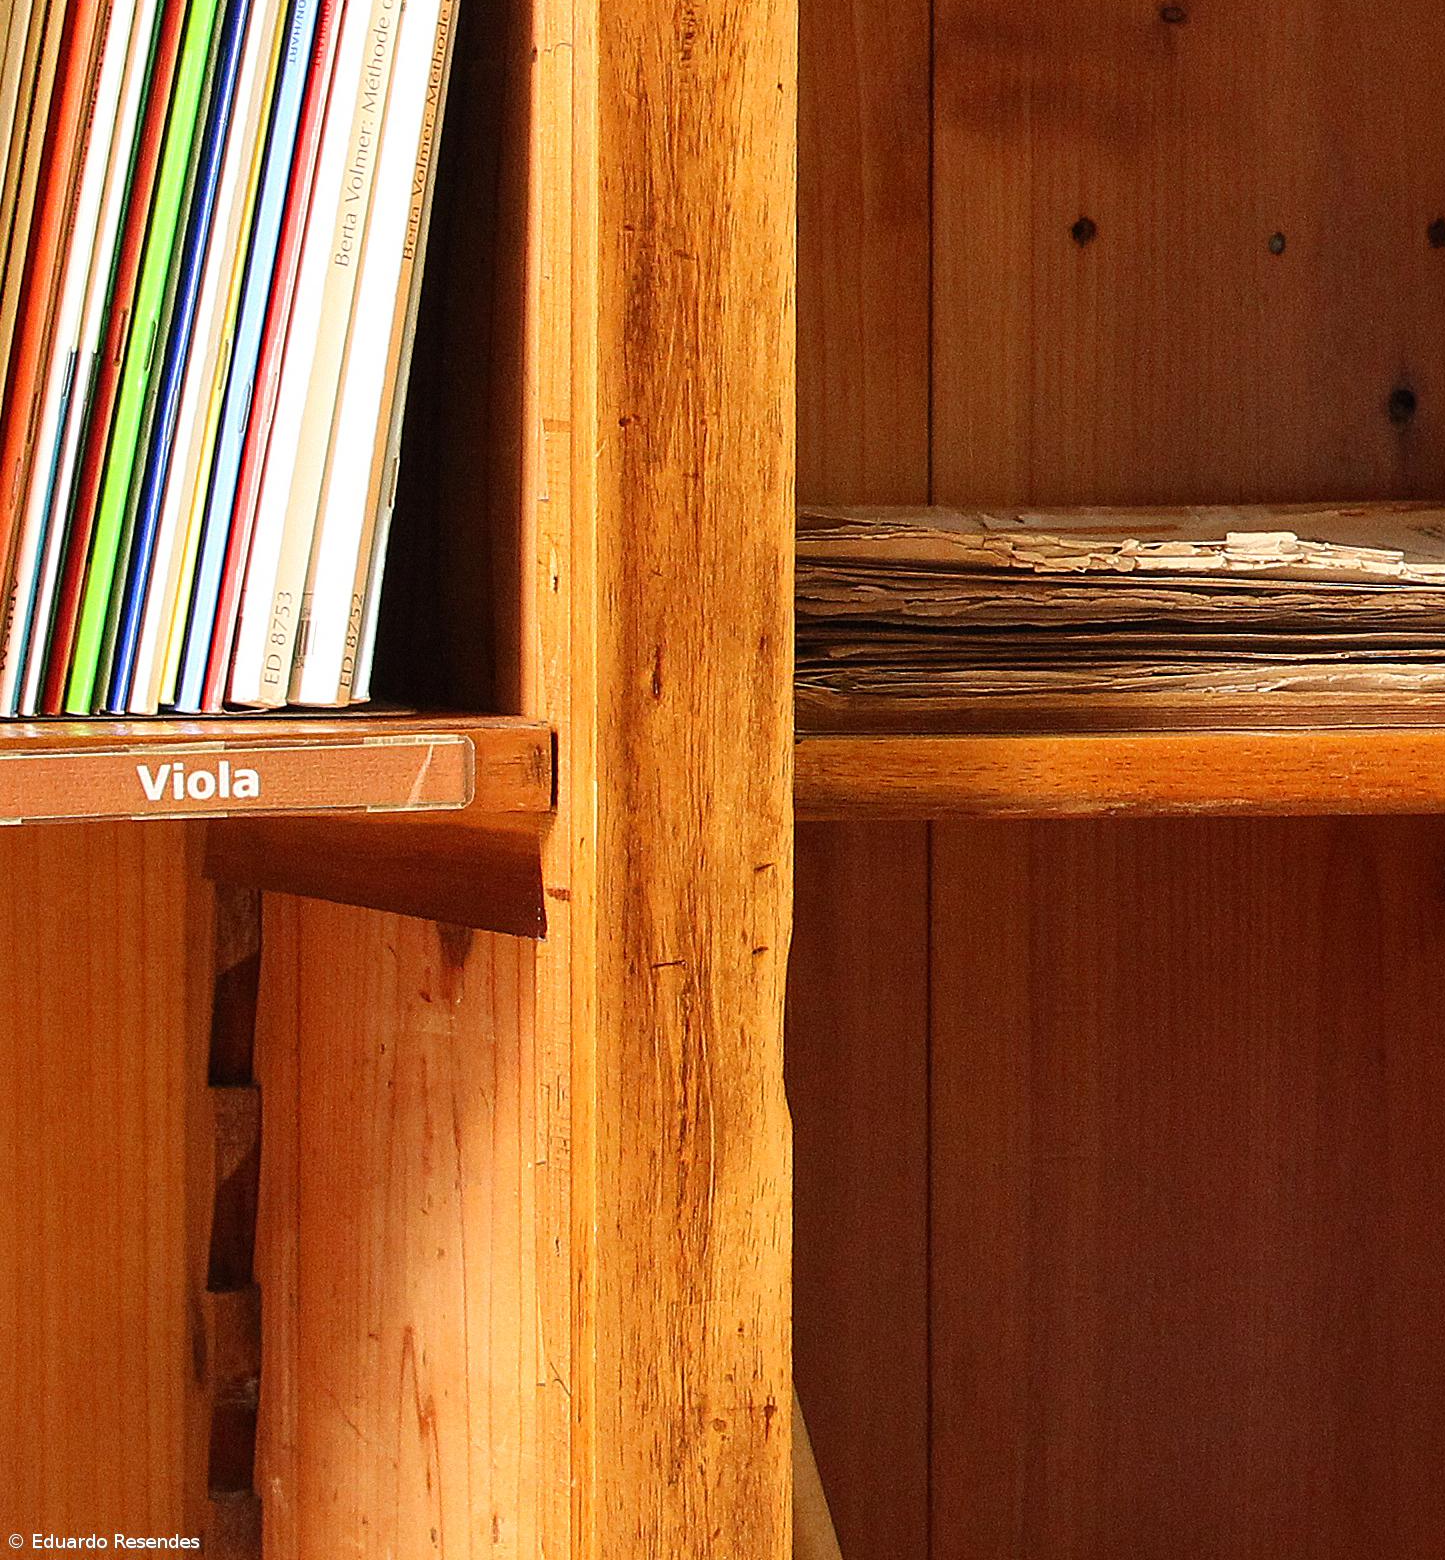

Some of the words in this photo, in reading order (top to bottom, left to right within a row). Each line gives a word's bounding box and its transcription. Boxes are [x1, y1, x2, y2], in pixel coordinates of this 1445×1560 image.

[362, 15, 391, 114] Méthode
[345, 119, 374, 204] Volmer:
[402, 206, 420, 261] Berta
[411, 112, 435, 198] Volmer:
[425, 9, 450, 107] Méthode
[334, 213, 358, 268] Berta
[270, 591, 293, 646] 8753
[346, 593, 363, 648] 8752
[263, 653, 282, 685] ED
[340, 656, 354, 687] ED
[136, 759, 260, 801] Viola
